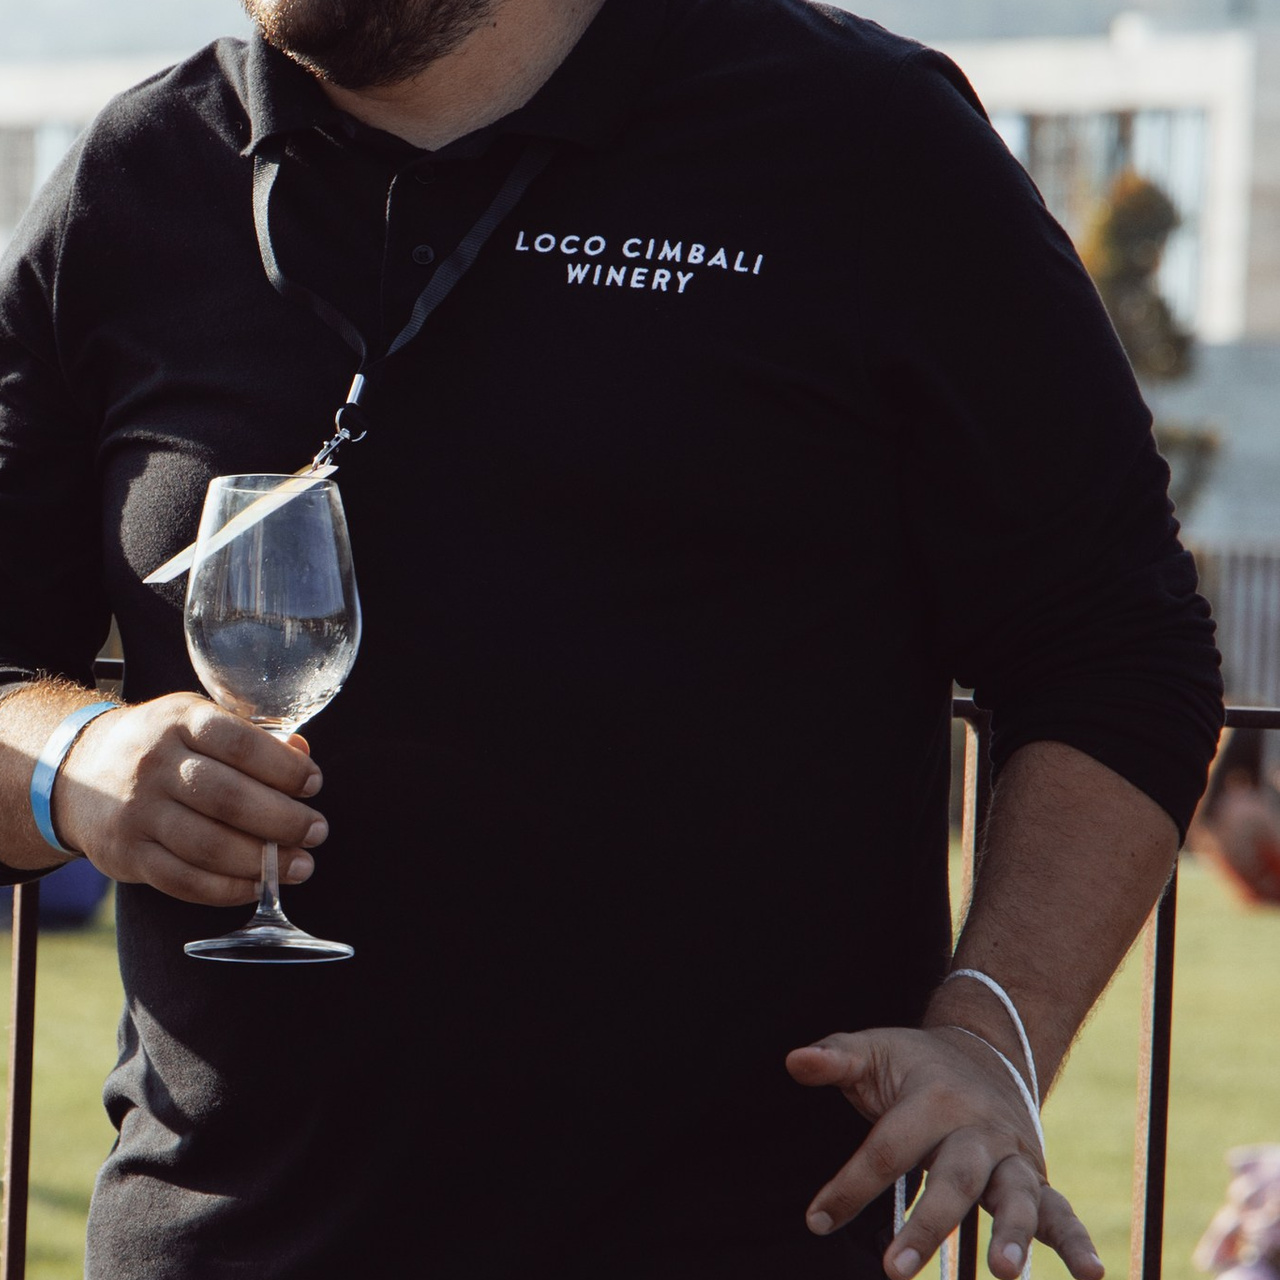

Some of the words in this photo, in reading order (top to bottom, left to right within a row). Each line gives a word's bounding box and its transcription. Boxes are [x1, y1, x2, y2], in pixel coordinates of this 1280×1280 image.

[515, 230, 606, 256] LOCO
[622, 237, 763, 275] CIMBALI
[567, 263, 693, 294] WINERY
